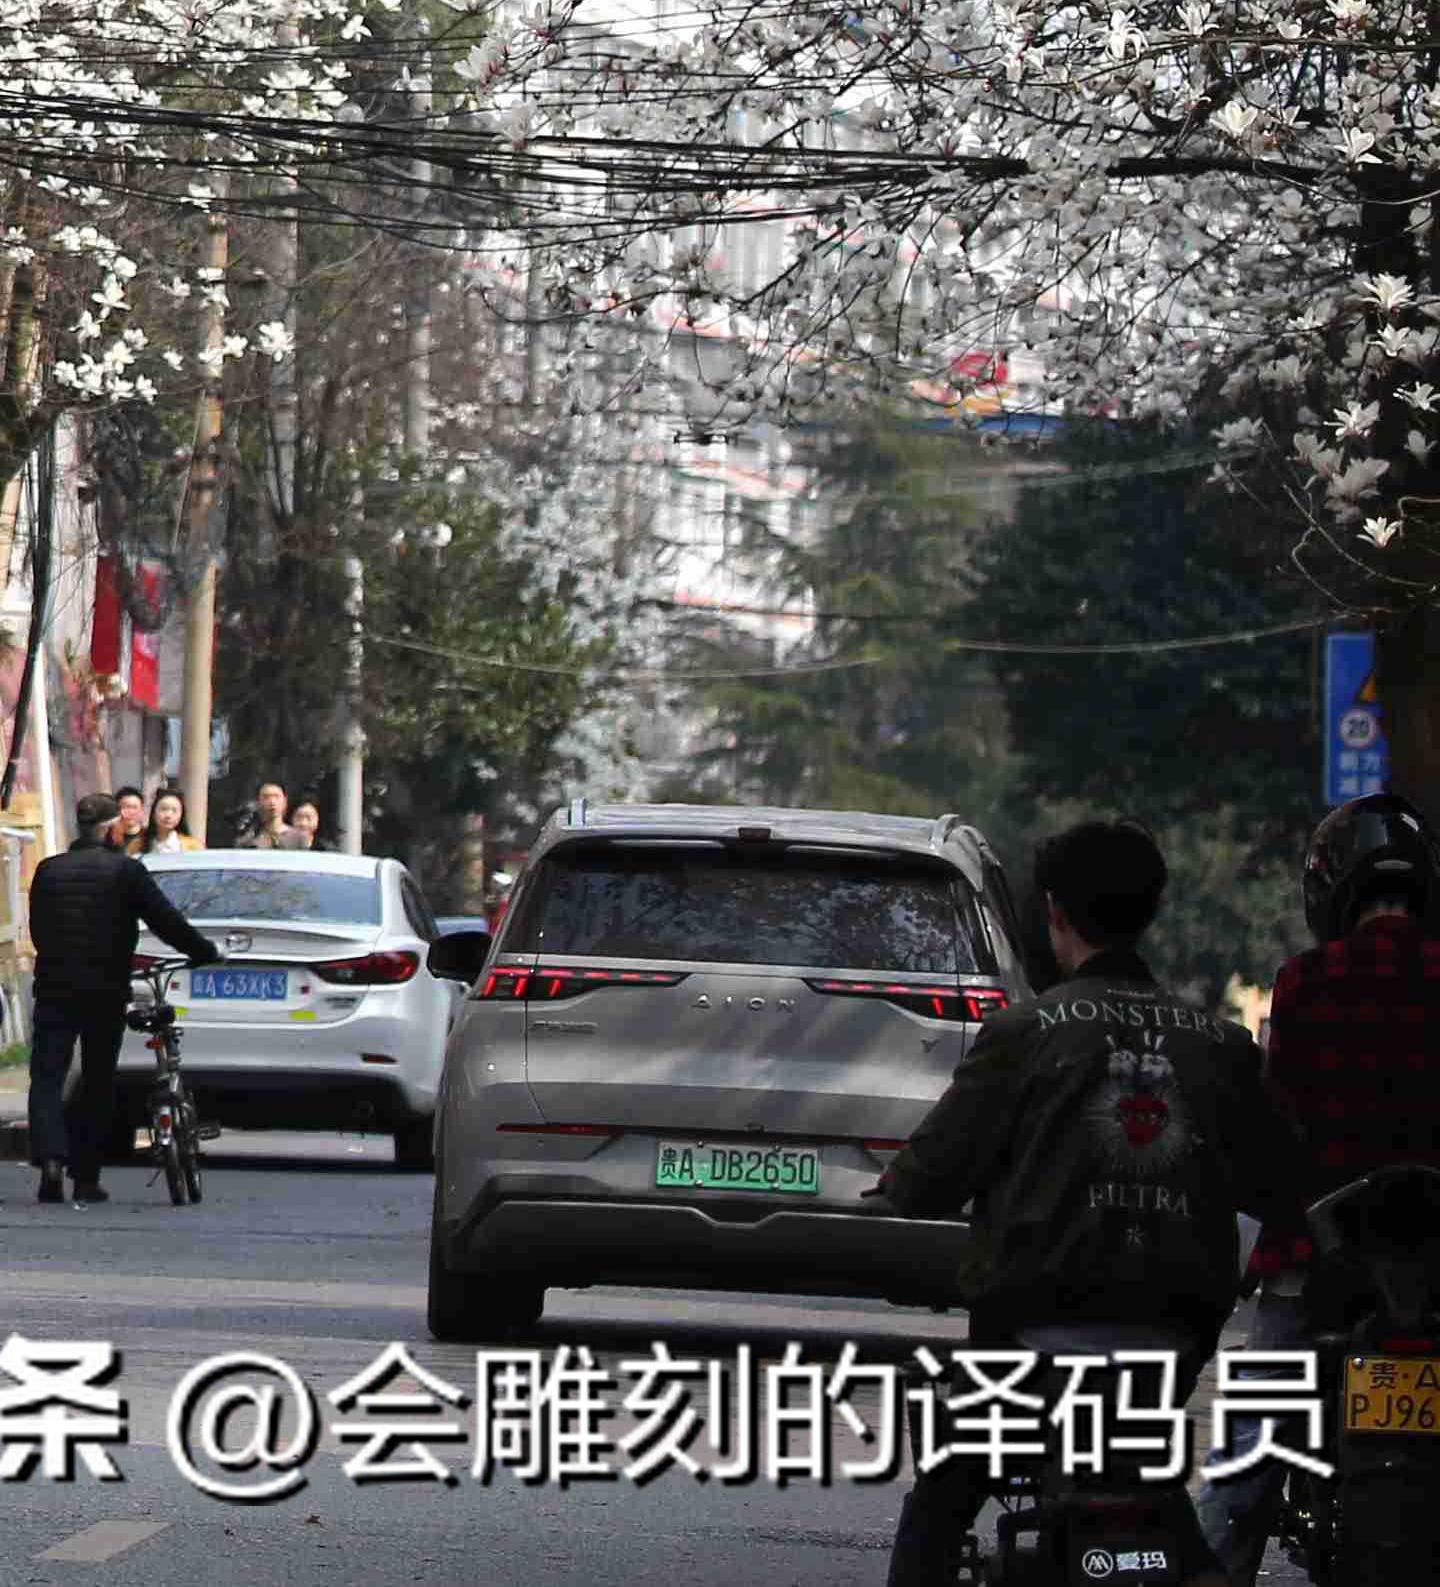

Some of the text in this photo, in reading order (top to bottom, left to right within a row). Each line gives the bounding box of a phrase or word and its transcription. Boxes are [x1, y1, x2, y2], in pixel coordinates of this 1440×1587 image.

[691, 994, 796, 1011] AION
[1037, 999, 1226, 1044] MONSTERS
[709, 1148, 816, 1186] DB2650
